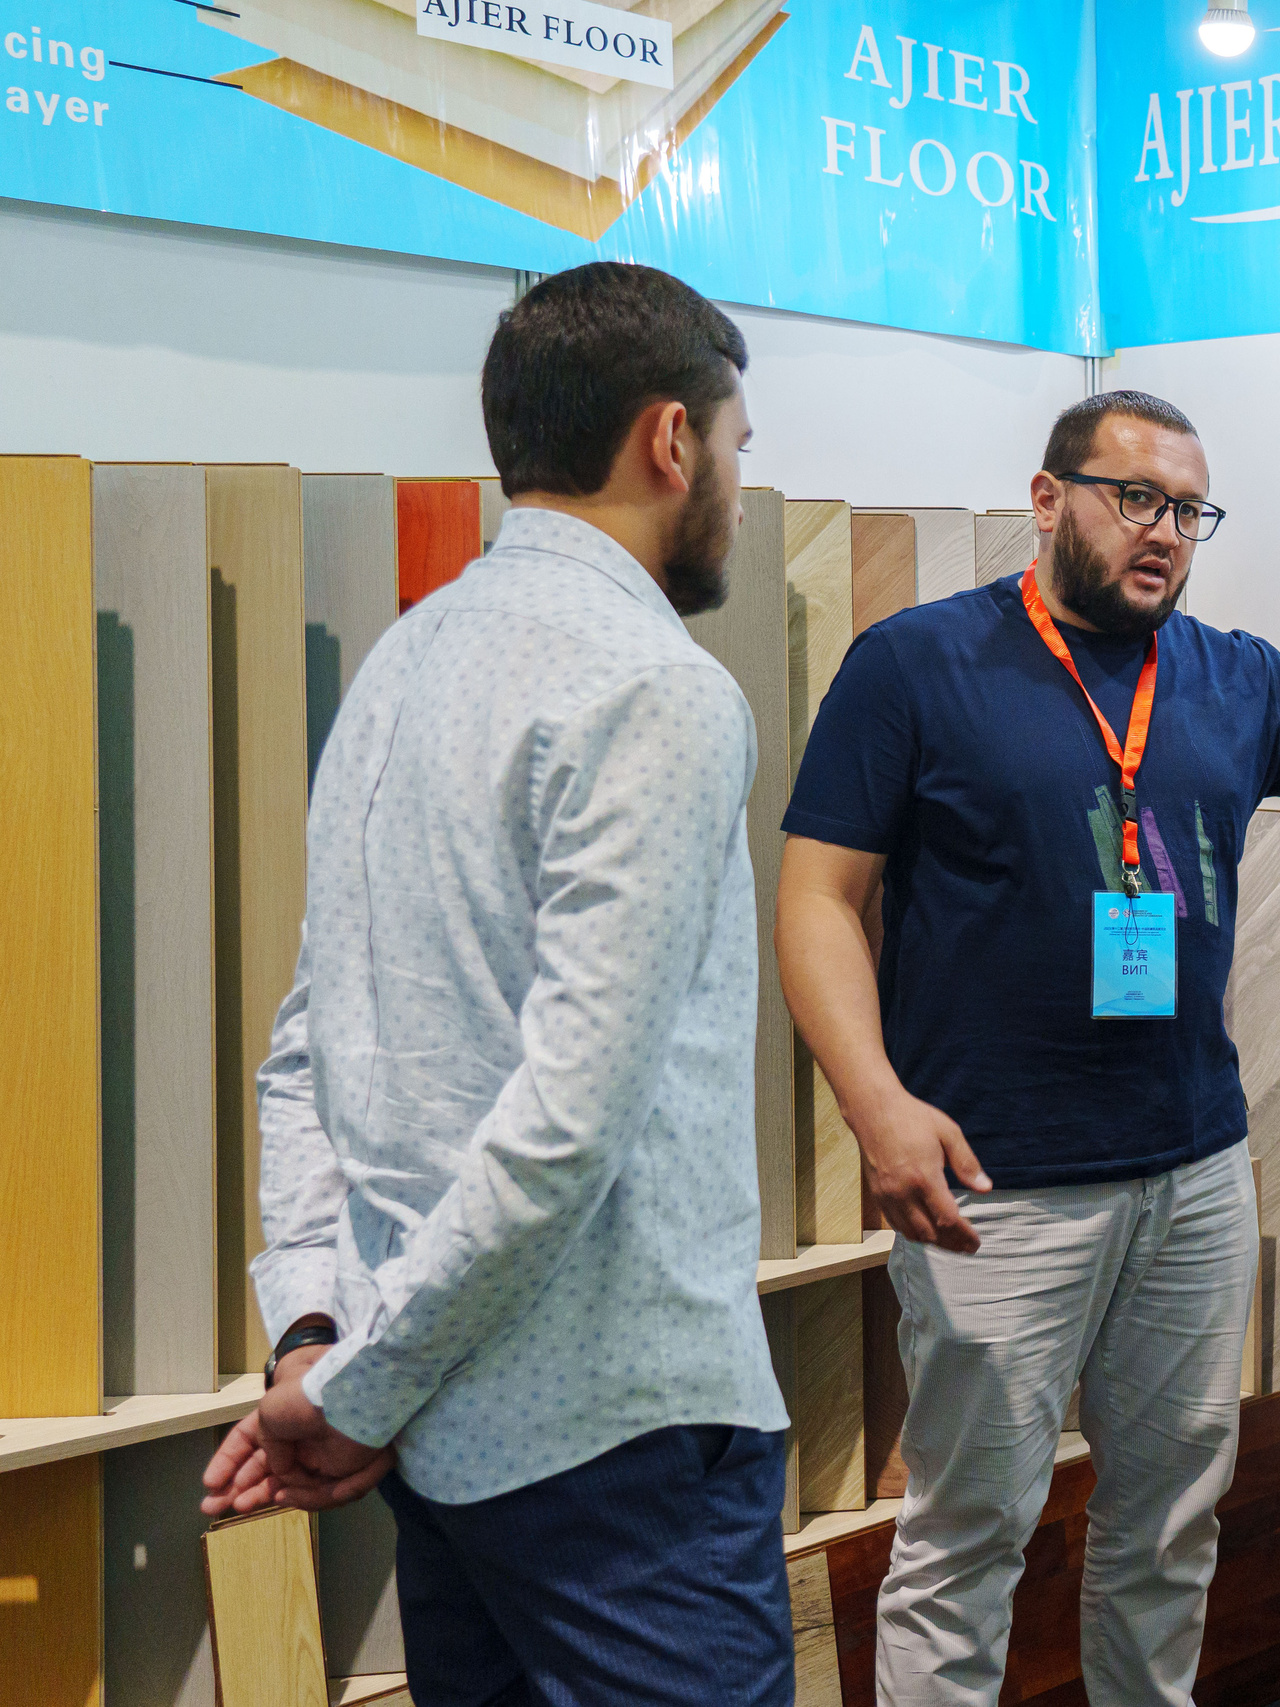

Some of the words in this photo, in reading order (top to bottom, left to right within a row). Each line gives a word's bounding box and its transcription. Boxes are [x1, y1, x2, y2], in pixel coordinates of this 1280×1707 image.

[4, 25, 105, 82] cing
[422, 0, 532, 36] AJIER
[543, 14, 663, 67] FLOOR
[843, 24, 1038, 125] AJIER
[5, 86, 110, 127] ayer
[820, 115, 1057, 223] FLOOR
[1122, 949, 1148, 961] 嘉宾
[1122, 964, 1148, 975] ВИП
